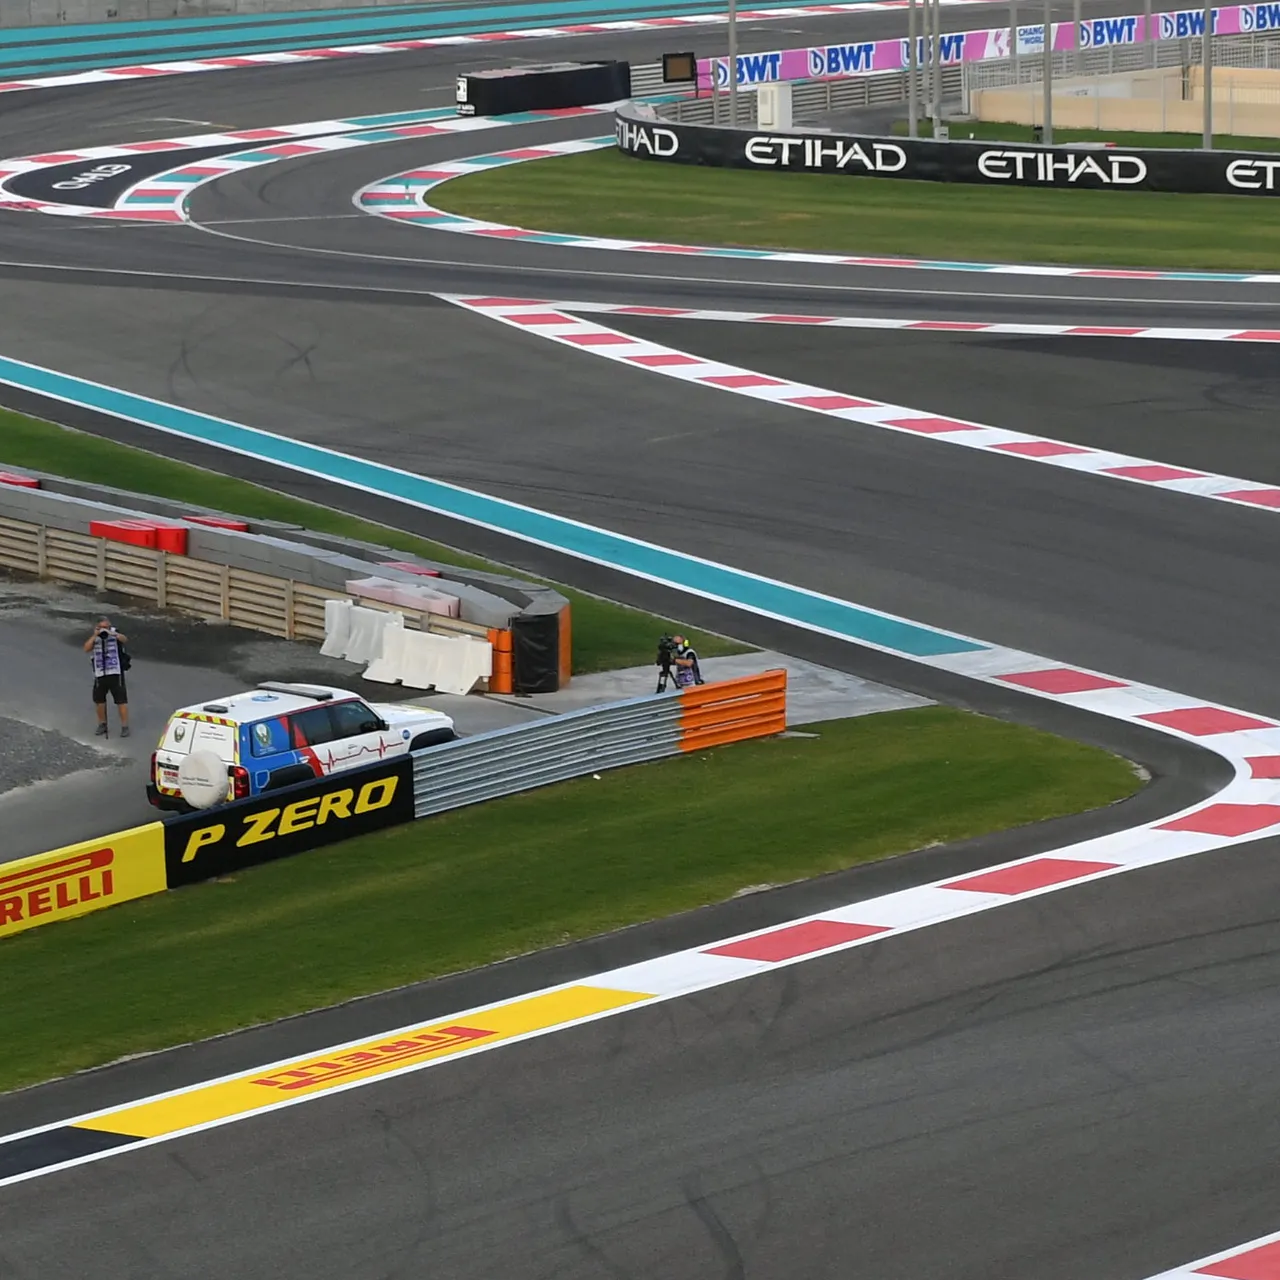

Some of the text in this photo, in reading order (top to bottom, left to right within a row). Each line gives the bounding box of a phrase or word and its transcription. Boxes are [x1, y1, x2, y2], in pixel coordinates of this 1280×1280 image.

[1018, 25, 1044, 36] CHANG
[1093, 18, 1136, 46] BWT
[827, 44, 874, 73] BWT
[616, 117, 679, 157] TIHAD
[744, 136, 906, 172] ETIHAD
[977, 150, 1147, 184] ETIHAD
[181, 775, 398, 863] P ZERO
[249, 1026, 499, 1090] PIRELLI
